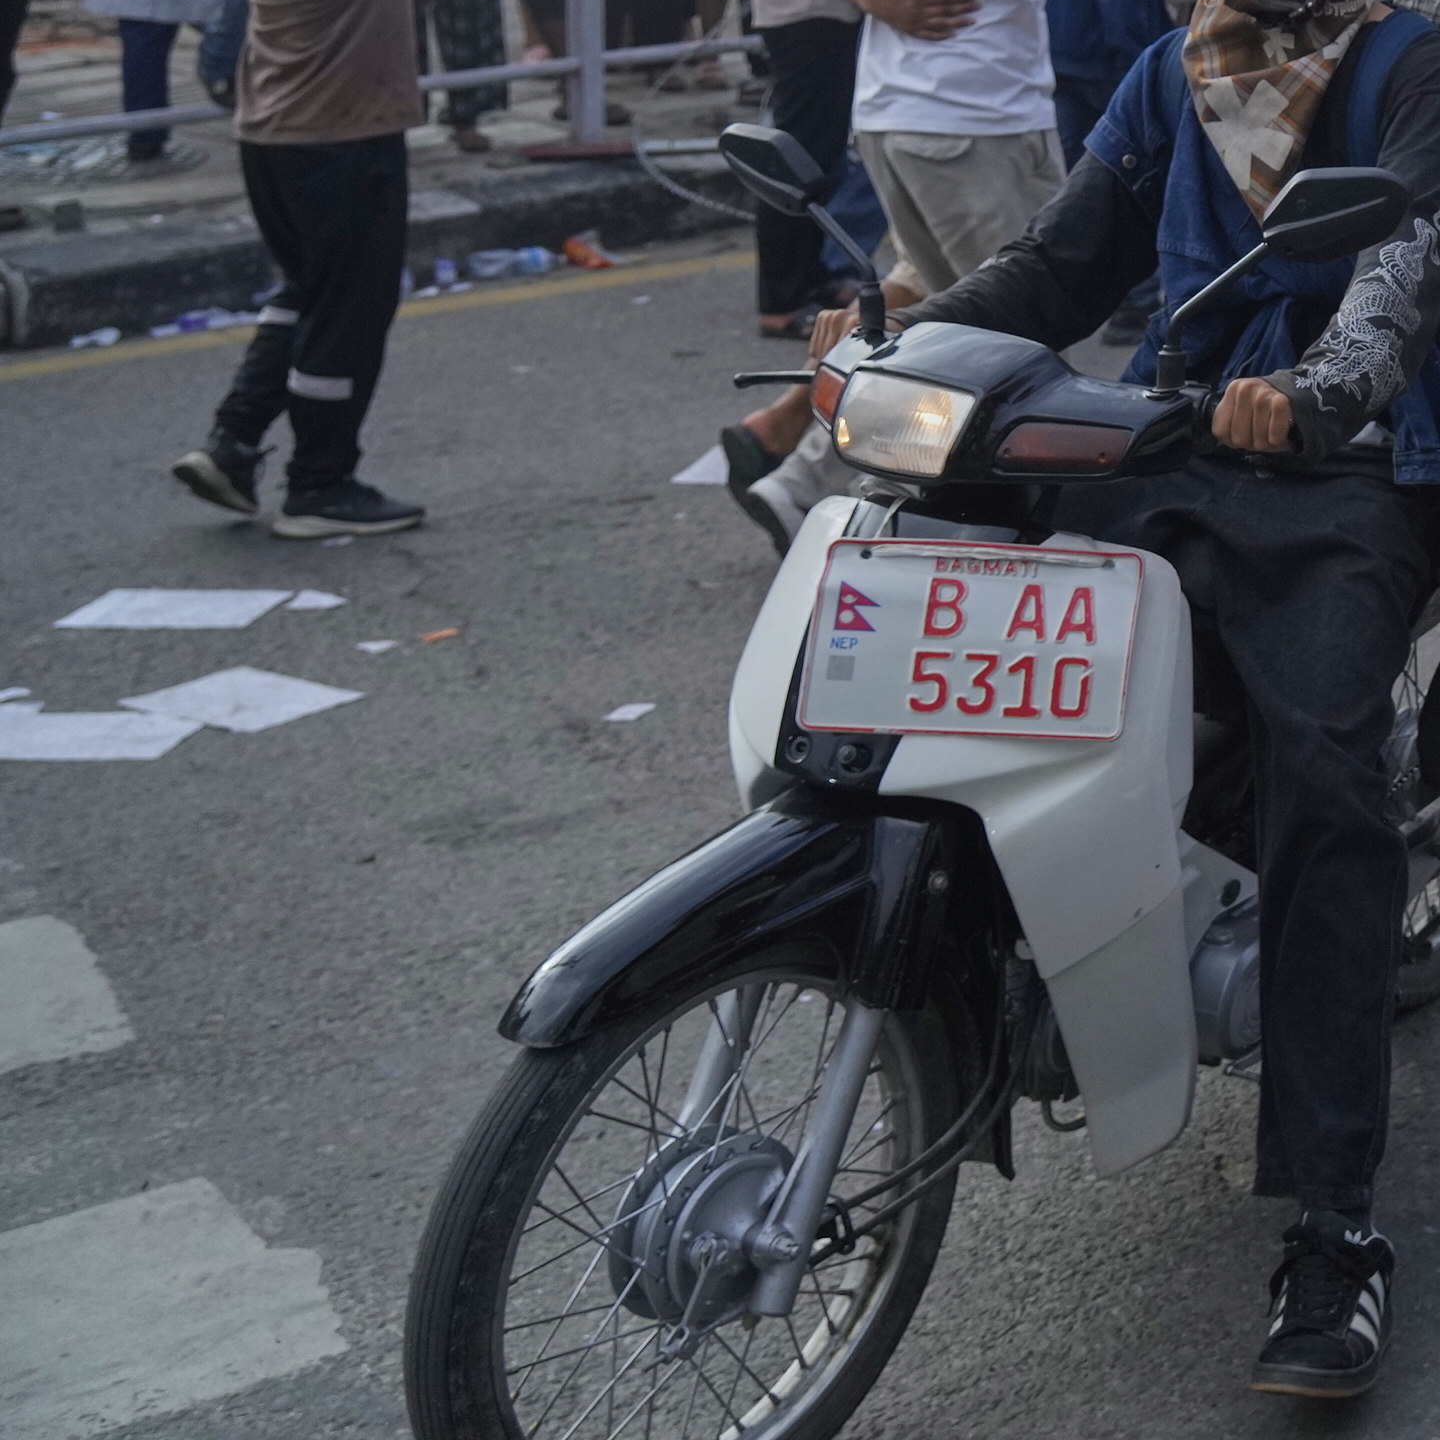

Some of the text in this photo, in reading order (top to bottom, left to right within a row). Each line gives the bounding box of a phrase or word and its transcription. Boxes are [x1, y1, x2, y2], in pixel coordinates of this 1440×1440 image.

[829, 637, 860, 650] NEP
[922, 577, 1096, 644] B AA
[908, 650, 1095, 720] 5310
